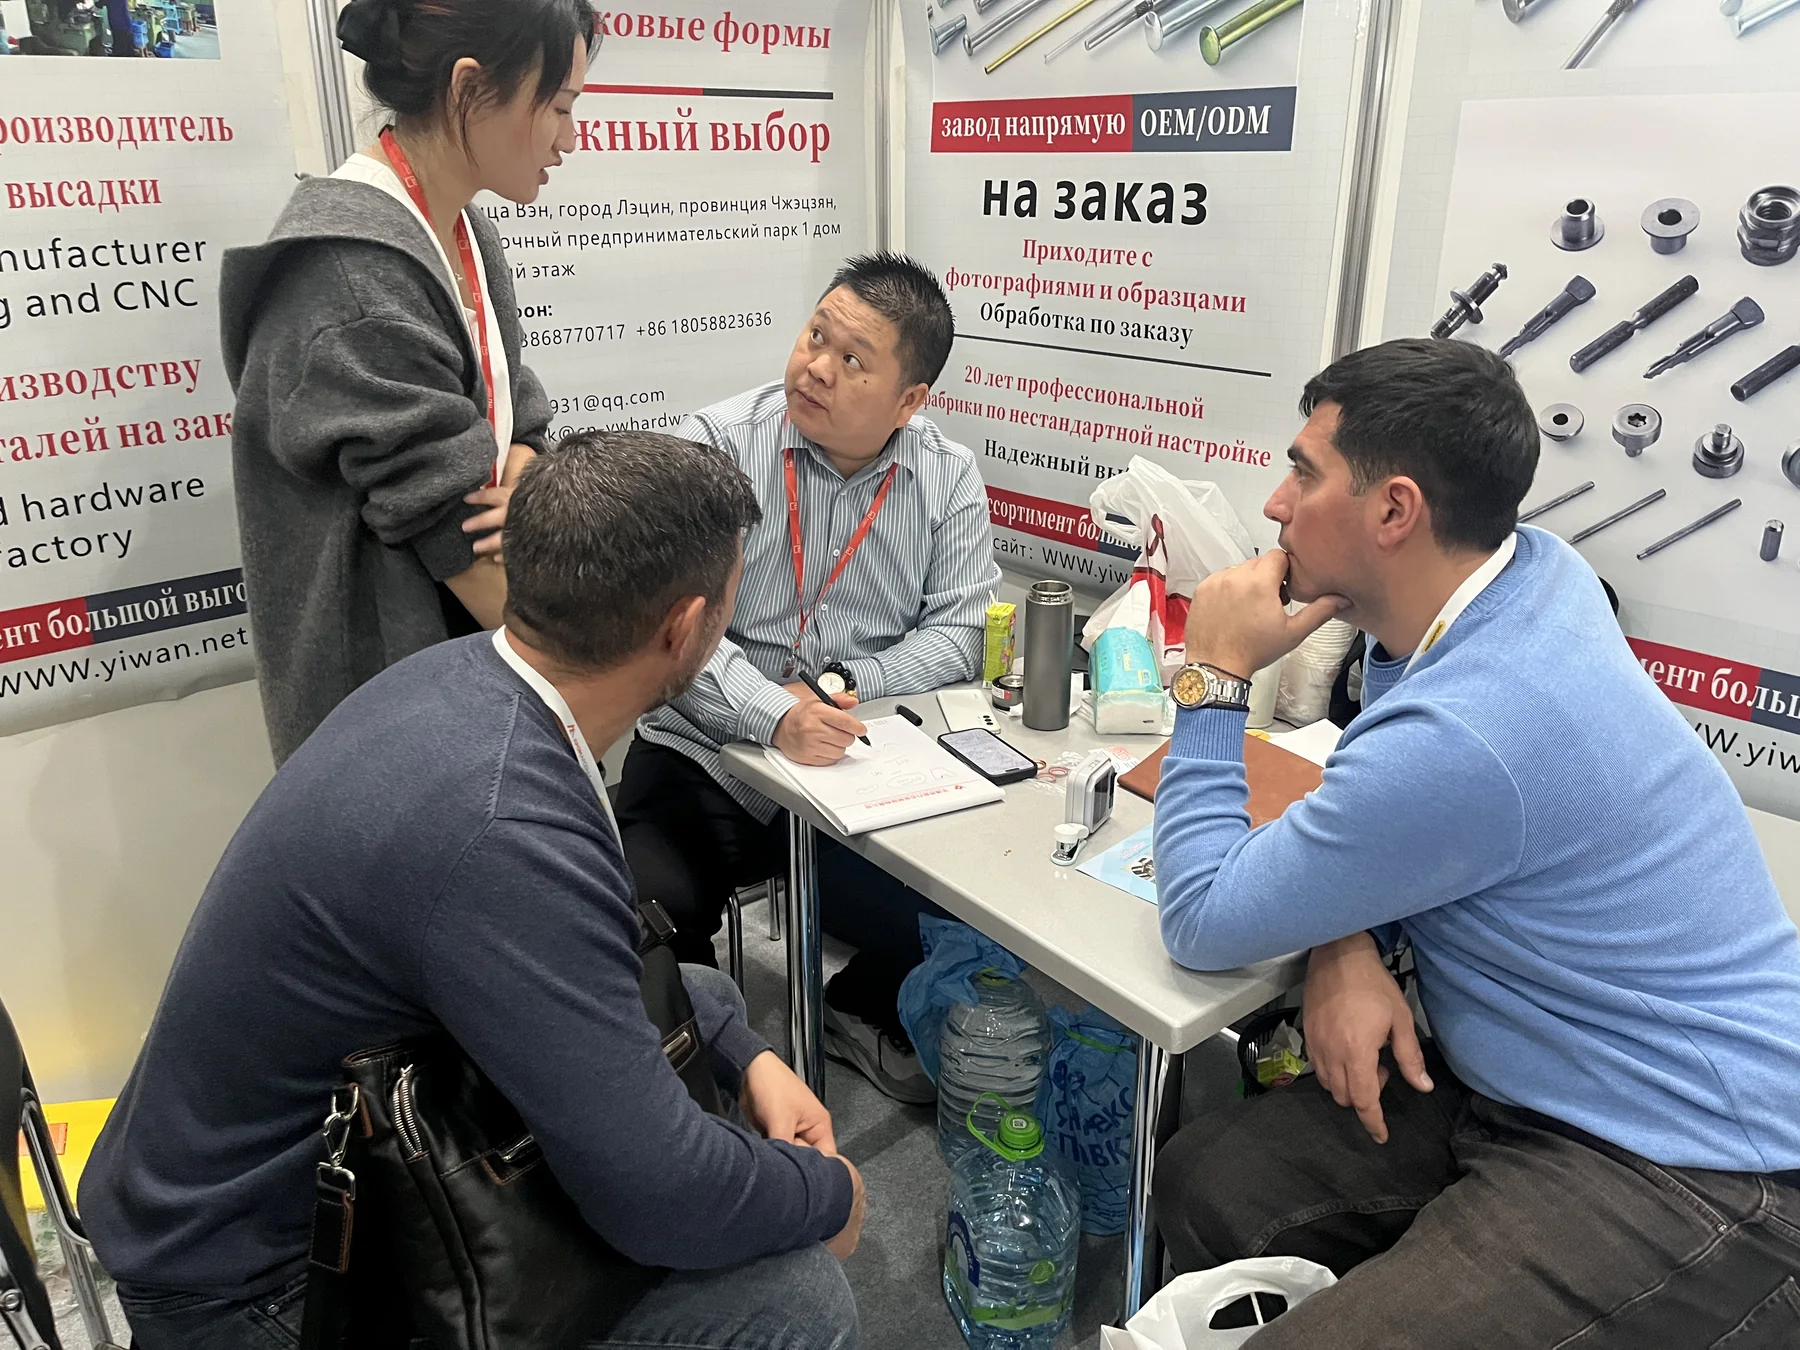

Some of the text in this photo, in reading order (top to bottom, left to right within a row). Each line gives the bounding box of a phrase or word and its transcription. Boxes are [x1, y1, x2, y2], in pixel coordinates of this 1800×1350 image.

[713, 11, 832, 54] формы
[710, 109, 832, 163] выбор
[941, 104, 1272, 144] завод напрямую OEM/ODM
[4, 178, 162, 213] высадки
[481, 205, 510, 222] ца
[559, 203, 612, 222] город
[616, 199, 675, 218] Лэцин,
[679, 198, 767, 218] провинция
[771, 194, 837, 212] Чжэцзян,
[982, 178, 1209, 226] на заказ
[567, 222, 760, 250] предпринимательский
[763, 225, 799, 243] парк
[802, 222, 809, 236] 1
[813, 223, 842, 239] дом
[1022, 238, 1154, 268] Приходите с
[532, 264, 576, 278] этаж
[945, 266, 1247, 314] фотографиями и образцами
[26, 283, 101, 318] and
[113, 278, 199, 311] CNC
[636, 321, 667, 338] +86
[671, 311, 773, 334] 18058823636
[979, 301, 1194, 349] Обработка по заказу
[964, 364, 1205, 420] 20 лет профессиональной
[116, 419, 166, 448] на
[986, 404, 1006, 420] по
[1009, 407, 1153, 447] нестандартной
[1157, 432, 1272, 468] настройке
[984, 438, 1090, 477] Надежный
[22, 477, 206, 523] hardware
[4, 528, 133, 569] actory
[1042, 546, 1132, 584] WWW.yiw
[48, 586, 181, 639] большой
[1693, 722, 1800, 775] W.yiw
